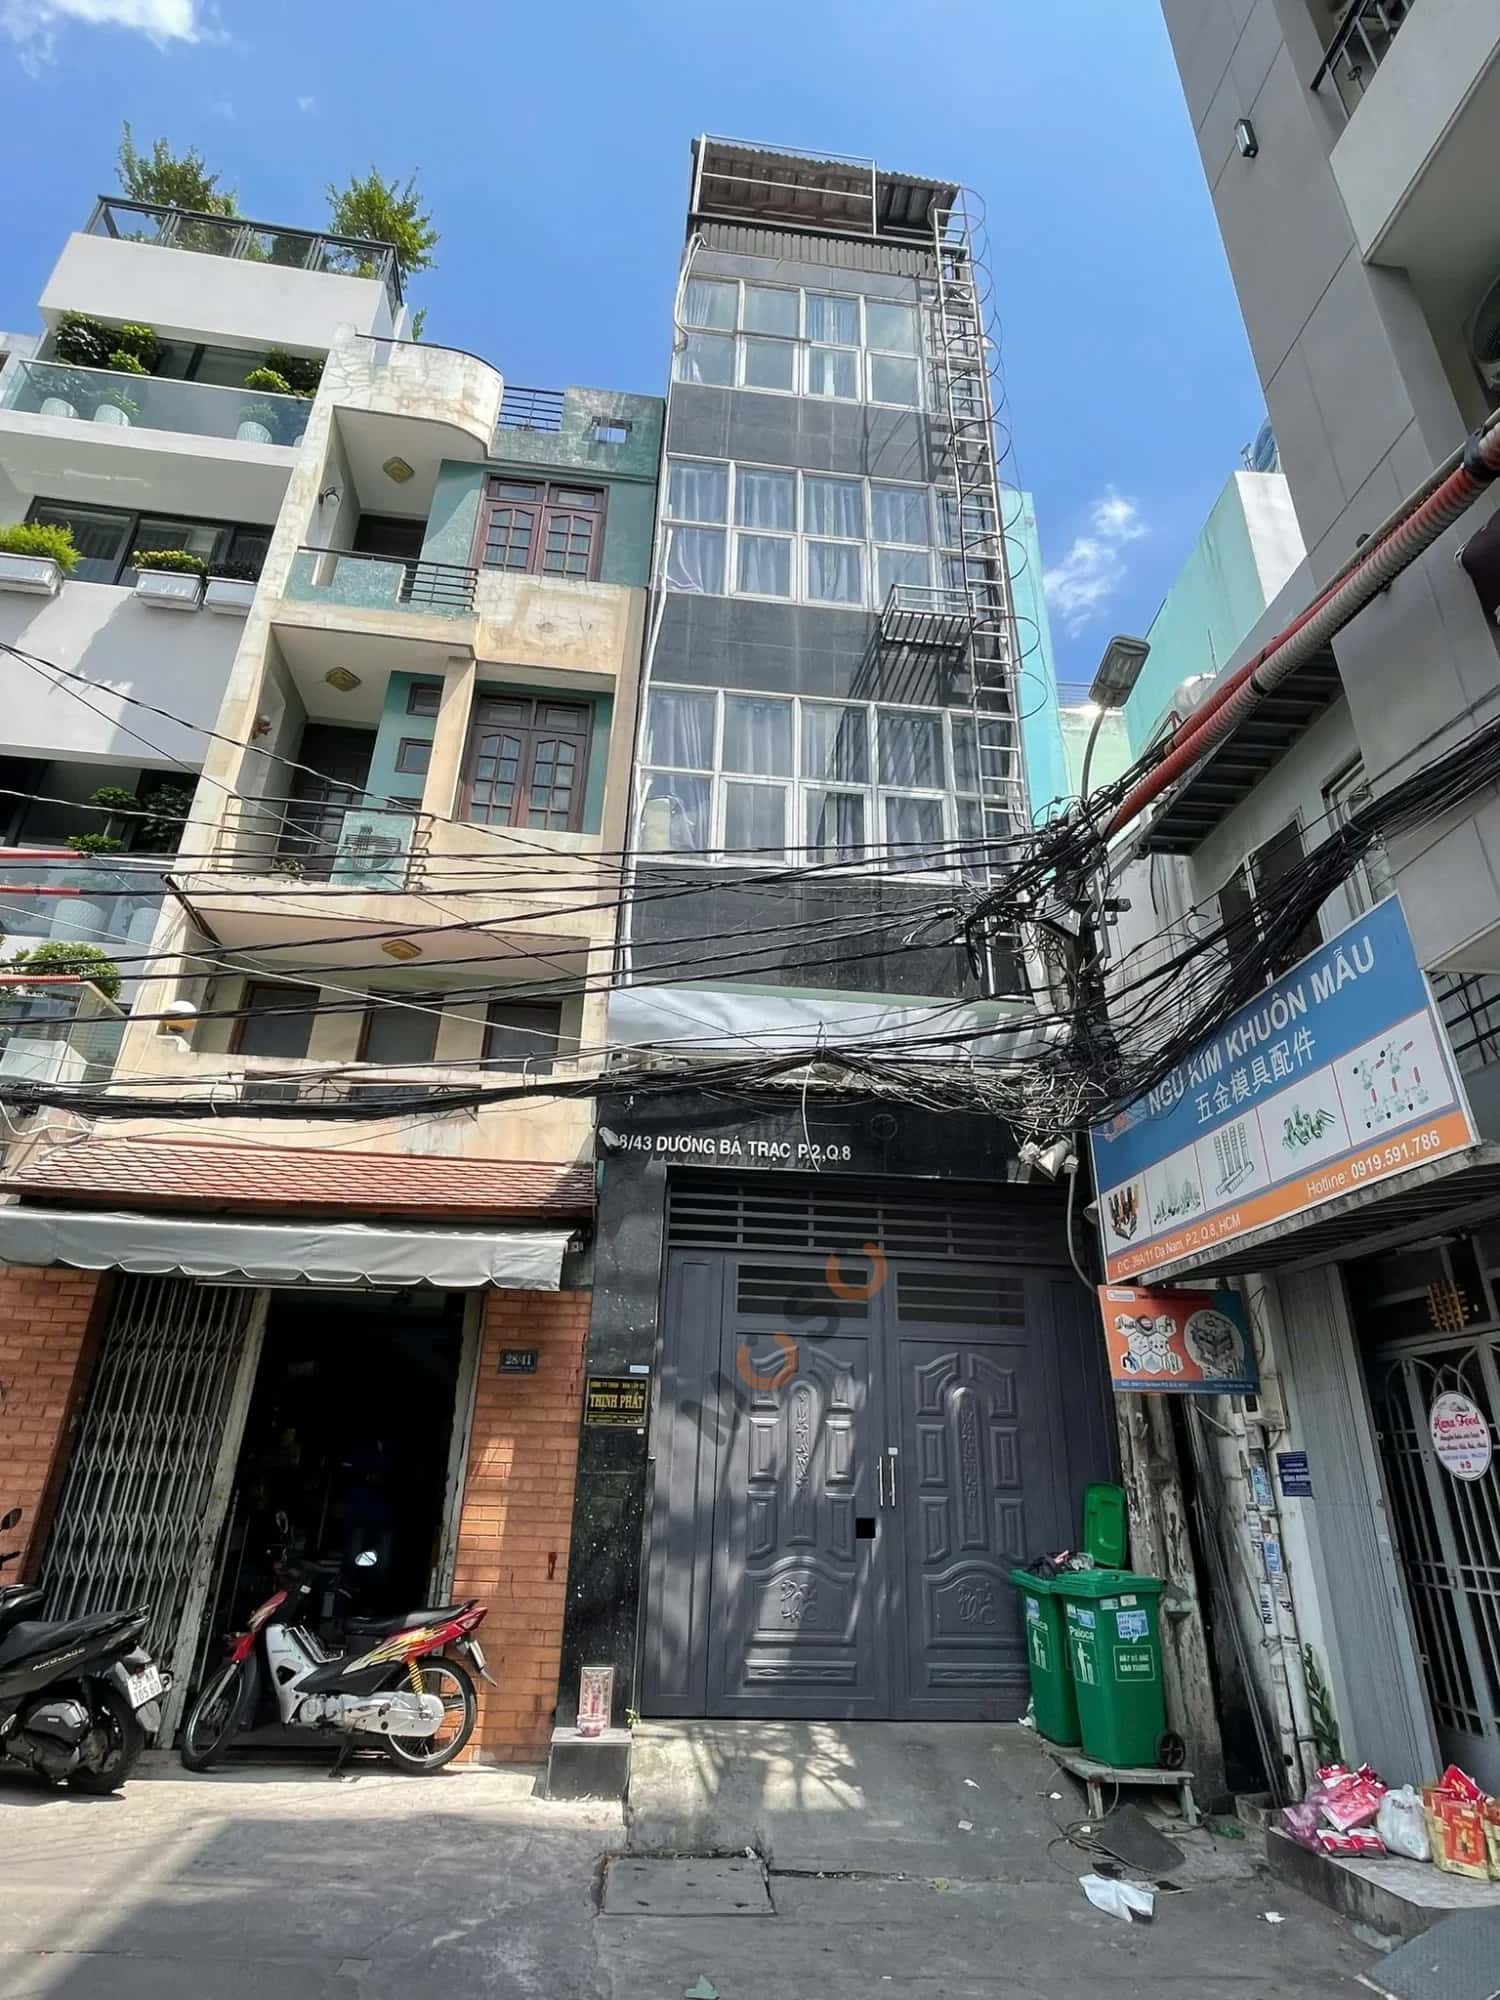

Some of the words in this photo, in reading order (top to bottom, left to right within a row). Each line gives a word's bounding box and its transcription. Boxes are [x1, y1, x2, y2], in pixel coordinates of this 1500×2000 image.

[1148, 1064, 1185, 1115] NGŨ
[1187, 1043, 1223, 1089] KIM
[1225, 984, 1308, 1063] KHUÔN
[1310, 936, 1376, 1004] MẪU
[1195, 1026, 1317, 1124] 五金模具配件
[656, 1135, 716, 1154] DƯƠNG
[719, 1135, 742, 1155] BÁ
[747, 1140, 790, 1162] TRẠC
[1307, 1170, 1350, 1198] Hotline:
[1351, 1130, 1441, 1179] 0919.591.786
[1219, 1212, 1241, 1232] HCM
[620, 1391, 644, 1409] PHÁT
